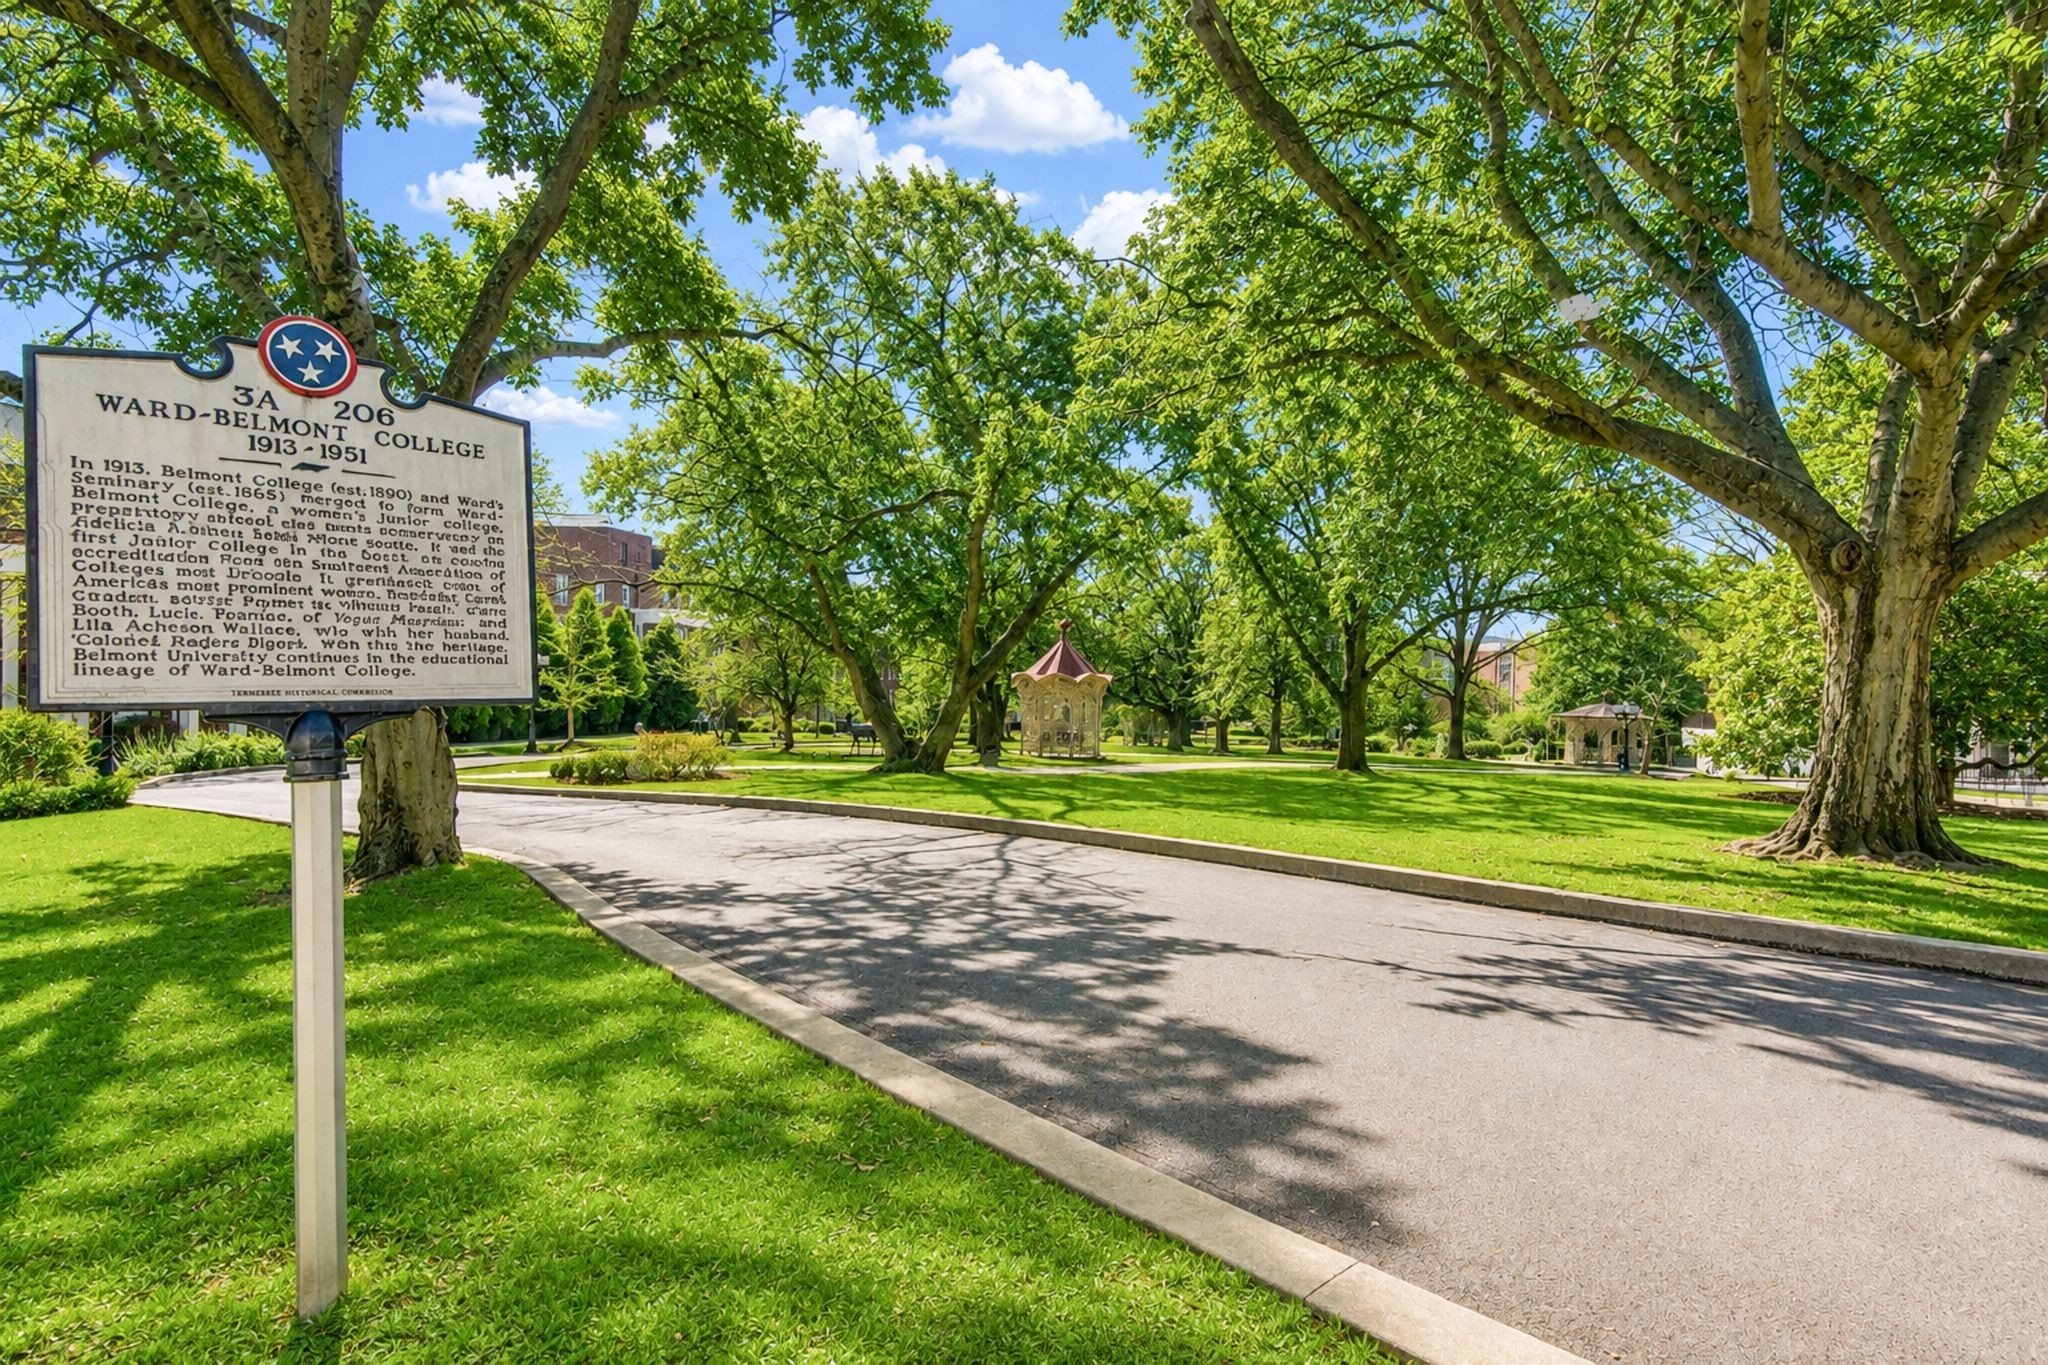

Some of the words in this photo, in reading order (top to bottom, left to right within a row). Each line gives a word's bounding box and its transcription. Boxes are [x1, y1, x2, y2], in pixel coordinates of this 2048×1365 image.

[233, 386, 280, 411] 3A
[334, 401, 395, 426] 206
[95, 393, 347, 441] WARD-BELMONT
[374, 430, 485, 459] COLLEGE
[70, 455, 93, 470] In
[161, 464, 242, 484] Belmont
[253, 474, 324, 493] College
[420, 494, 450, 505] and
[457, 496, 504, 510] Ward's
[71, 485, 159, 504] Belmont
[71, 471, 174, 493] Seminary
[457, 508, 503, 520] Ward-
[70, 529, 117, 544] first
[208, 540, 279, 557] College
[290, 544, 306, 556] in
[490, 571, 506, 581] of
[228, 583, 314, 597] prominent
[491, 582, 506, 593] of
[72, 618, 113, 631] Lila
[126, 620, 214, 634] Acheson
[408, 628, 434, 639] her
[303, 612, 322, 623] of
[479, 618, 507, 629] and
[73, 648, 158, 662] Belmont
[367, 653, 382, 664] in
[421, 654, 509, 665] educational
[73, 663, 155, 679] lineage
[169, 664, 190, 676] of
[200, 664, 335, 676] Ward-Belmont
